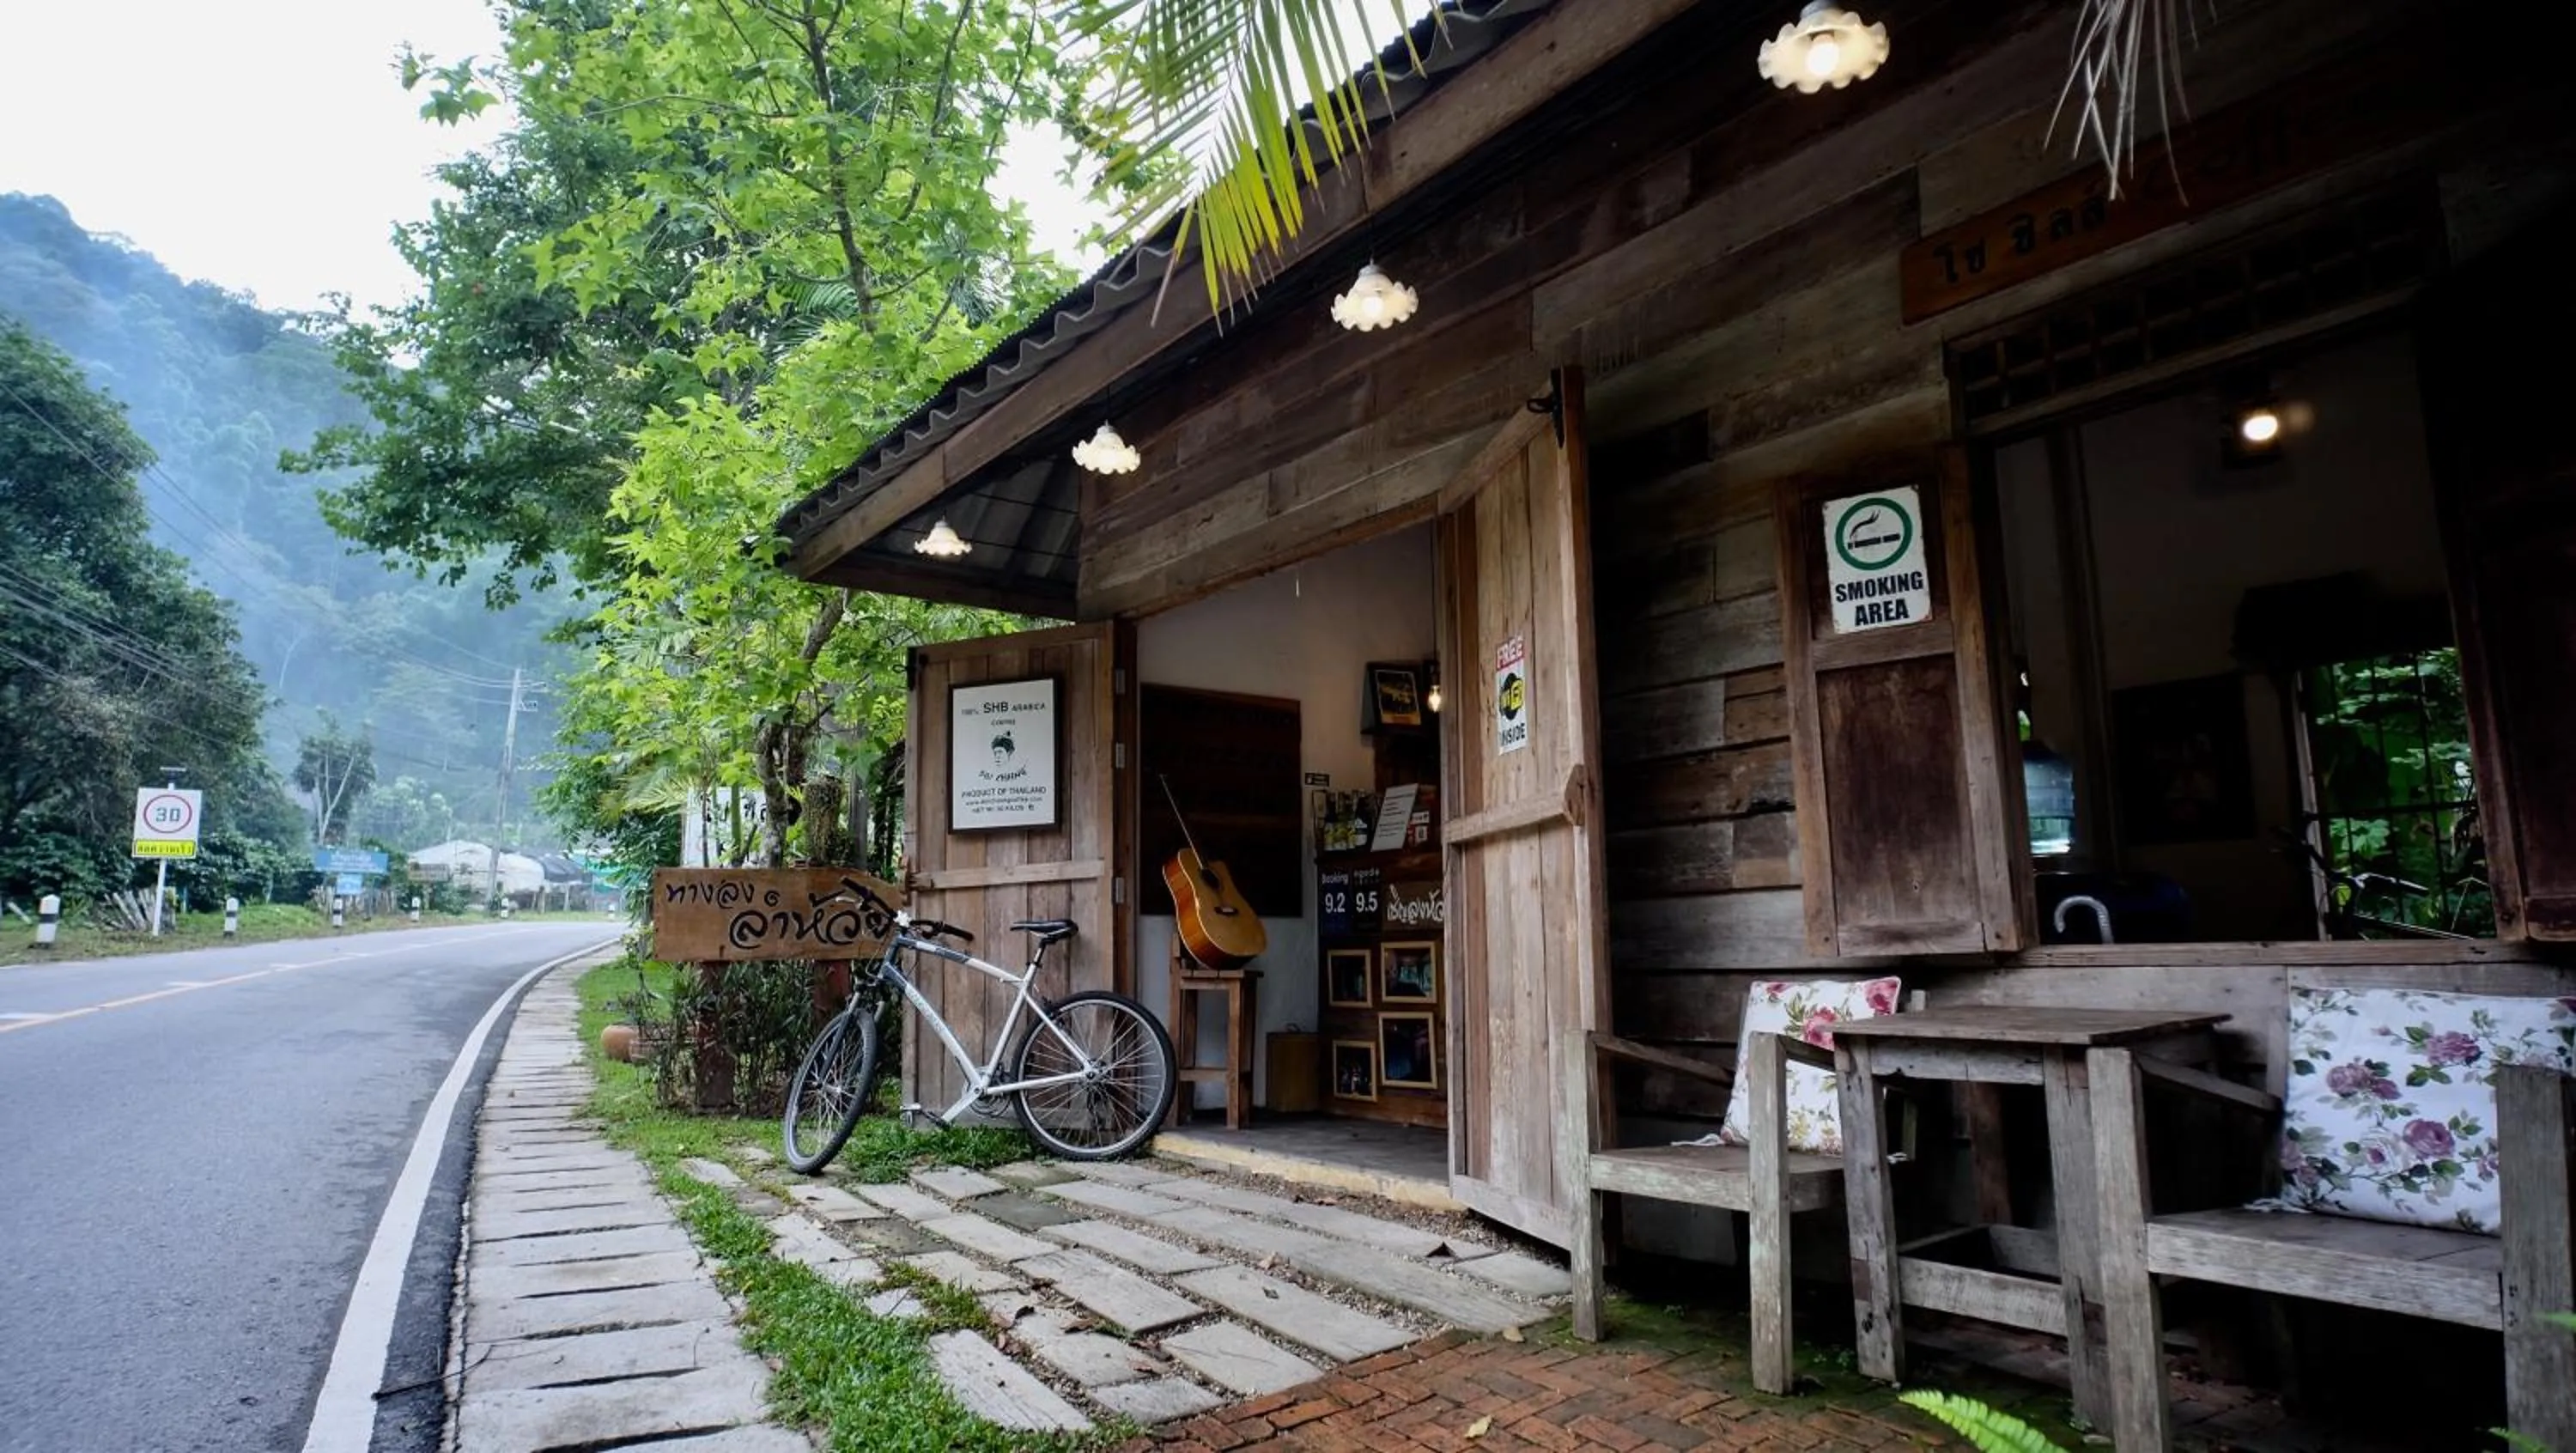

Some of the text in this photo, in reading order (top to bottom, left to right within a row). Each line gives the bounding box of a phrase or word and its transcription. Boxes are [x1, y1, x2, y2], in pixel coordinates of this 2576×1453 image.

[1835, 571, 1923, 603] SMOKING
[1855, 599, 1910, 626] AREA
[1497, 635, 1524, 668] FREE
[983, 702, 1009, 714] SHB
[1500, 723, 1525, 746] INSIDE
[962, 787, 995, 798] PRODUCT
[1010, 786, 1047, 795] THAILAND
[155, 807, 180, 822] 30
[1321, 872, 1349, 885] Booking
[665, 879, 755, 909] ทางลง
[1325, 892, 1346, 914] 9.2
[1356, 891, 1378, 914] 9.5
